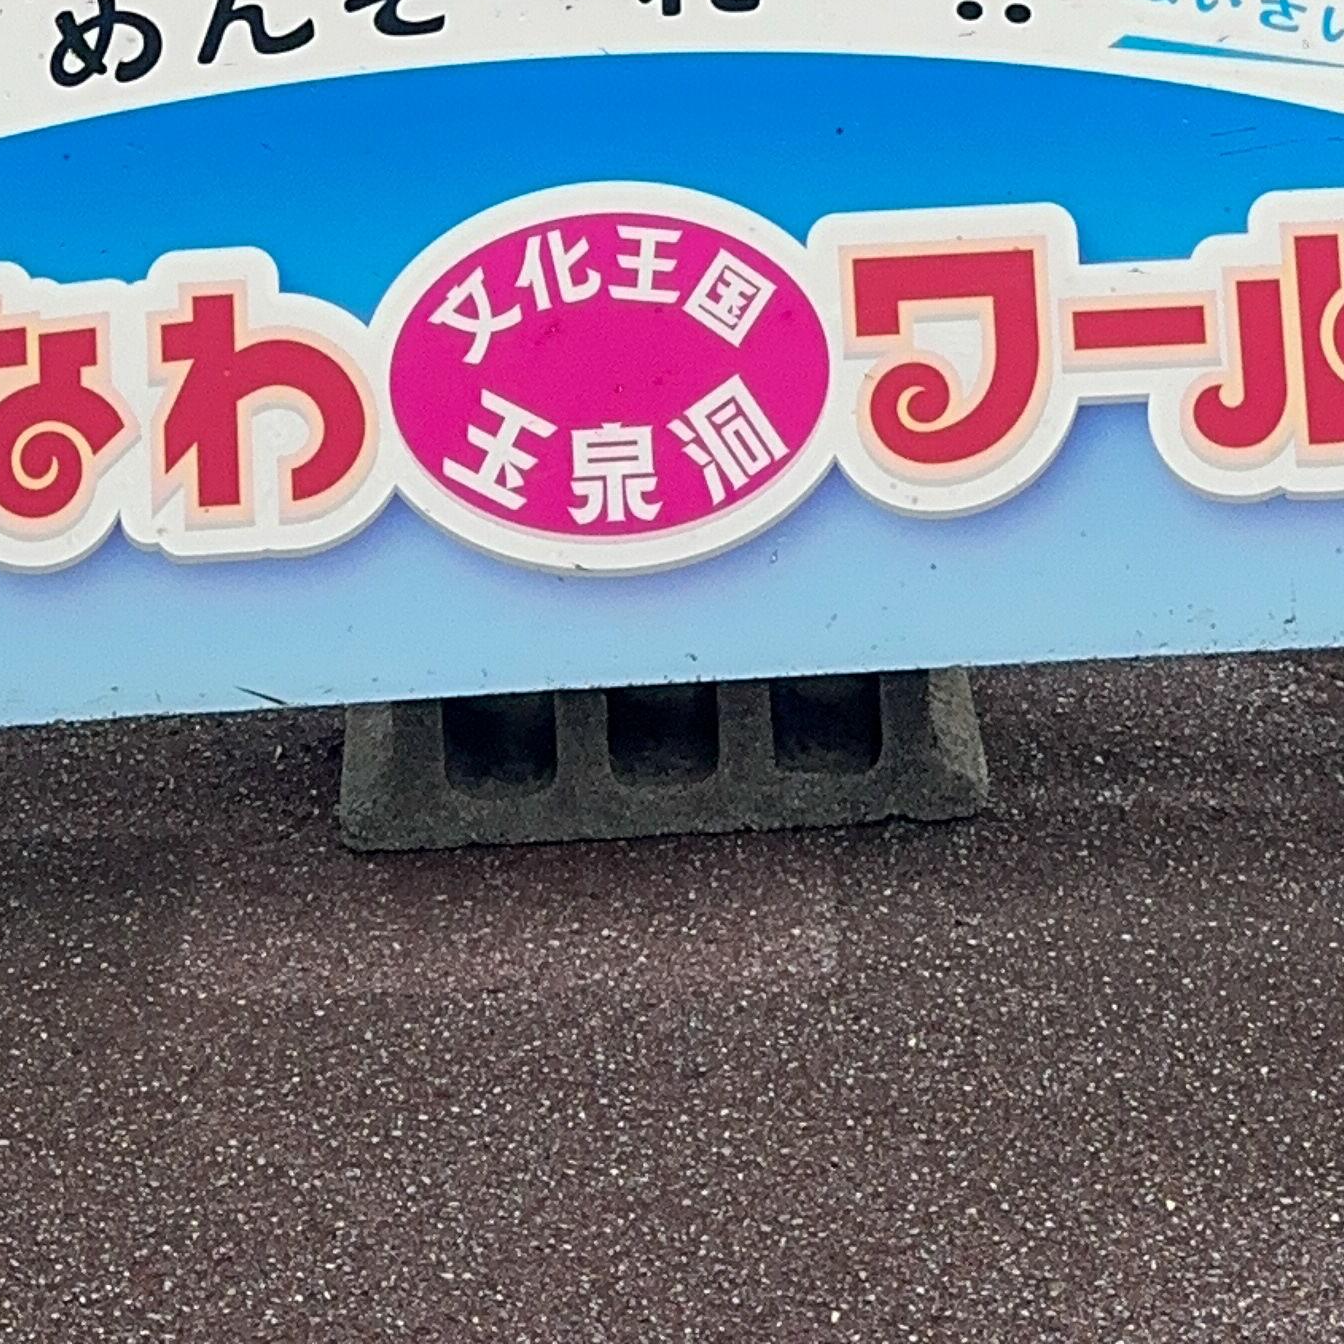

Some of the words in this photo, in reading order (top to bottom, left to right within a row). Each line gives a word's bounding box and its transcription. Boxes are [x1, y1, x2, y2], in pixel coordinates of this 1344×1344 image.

[427, 224, 778, 365] 文化王国
[442, 373, 791, 525] 玉泉洞
